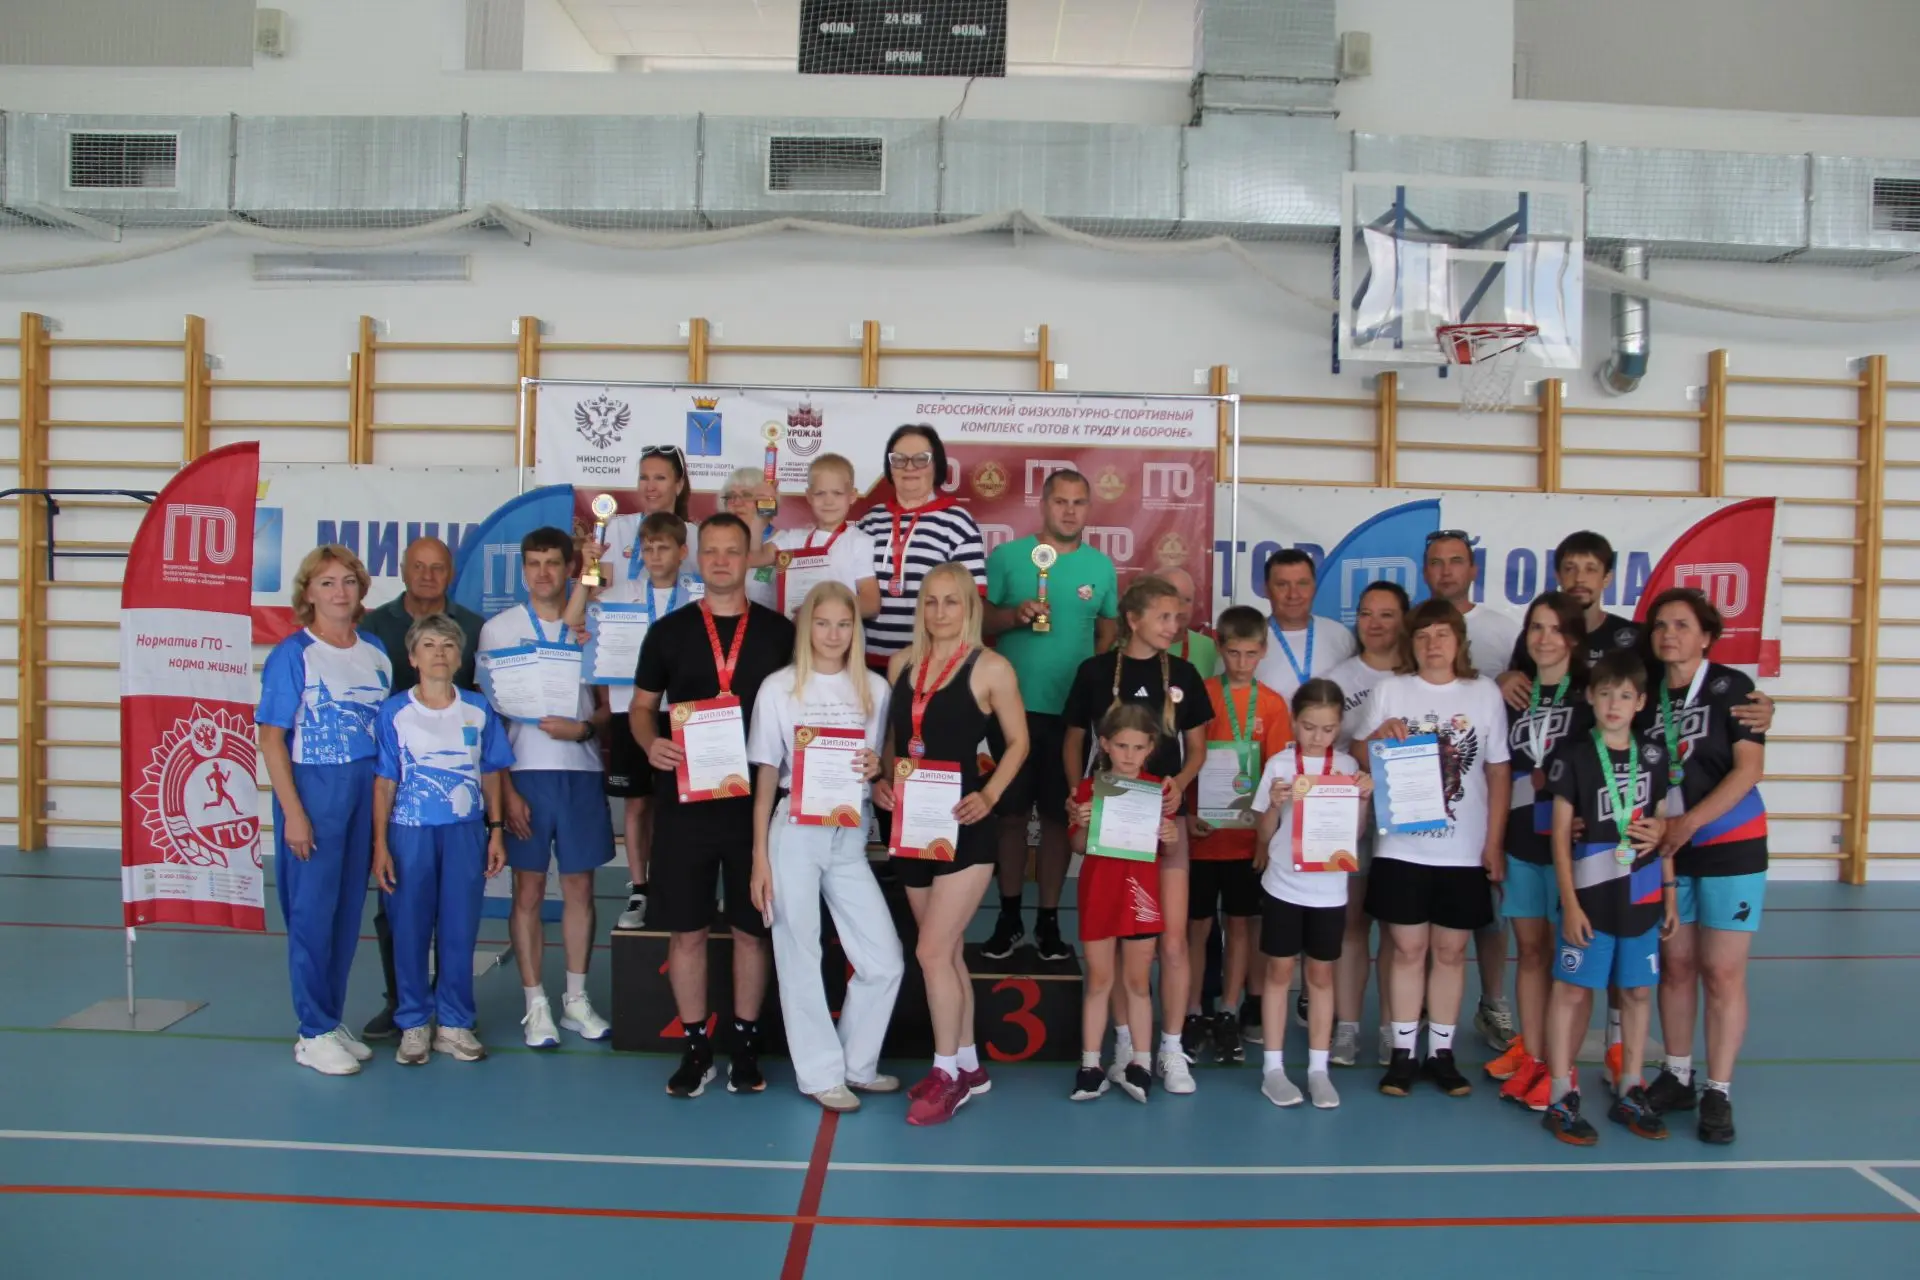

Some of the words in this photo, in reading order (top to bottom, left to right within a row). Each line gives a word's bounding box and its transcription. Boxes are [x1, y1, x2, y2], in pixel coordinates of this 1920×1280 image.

[885, 13, 899, 24] 24
[902, 13, 922, 25] СЕК
[819, 22, 854, 34] ФОЛЫ
[951, 25, 986, 36] ФОЛЫ
[885, 51, 922, 62] ВРЕМЯ
[916, 402, 1016, 417] ВСЕРОССИЙСКИЙ
[1018, 403, 1194, 421] ФИЗКУЛЬТУРНО-СПОРТИВНЫЙ
[787, 428, 822, 438] УРОЖАЙ
[960, 421, 1024, 434] КОМПЛЕКС
[1072, 425, 1080, 436] К
[1084, 425, 1120, 438] ТРУДУ
[1122, 426, 1131, 437] И
[576, 455, 627, 465] МИНСПОРТ
[582, 465, 621, 475] РОССИИ
[1143, 462, 1194, 498] ГТО
[163, 503, 237, 564] ГТО
[604, 613, 638, 621] ДИПЛОМ
[136, 634, 198, 649] Норматив
[200, 636, 223, 650] ГТО
[539, 649, 571, 658] ДИПЛОМ
[168, 657, 205, 671] норма
[207, 661, 248, 676] жизни!
[698, 709, 734, 721] ДИПЛОМ
[820, 739, 857, 748] ДИПЛОМ
[919, 771, 955, 781] ДИПЛОМ
[213, 821, 254, 845] ГТО
[985, 975, 1047, 1061] 3
